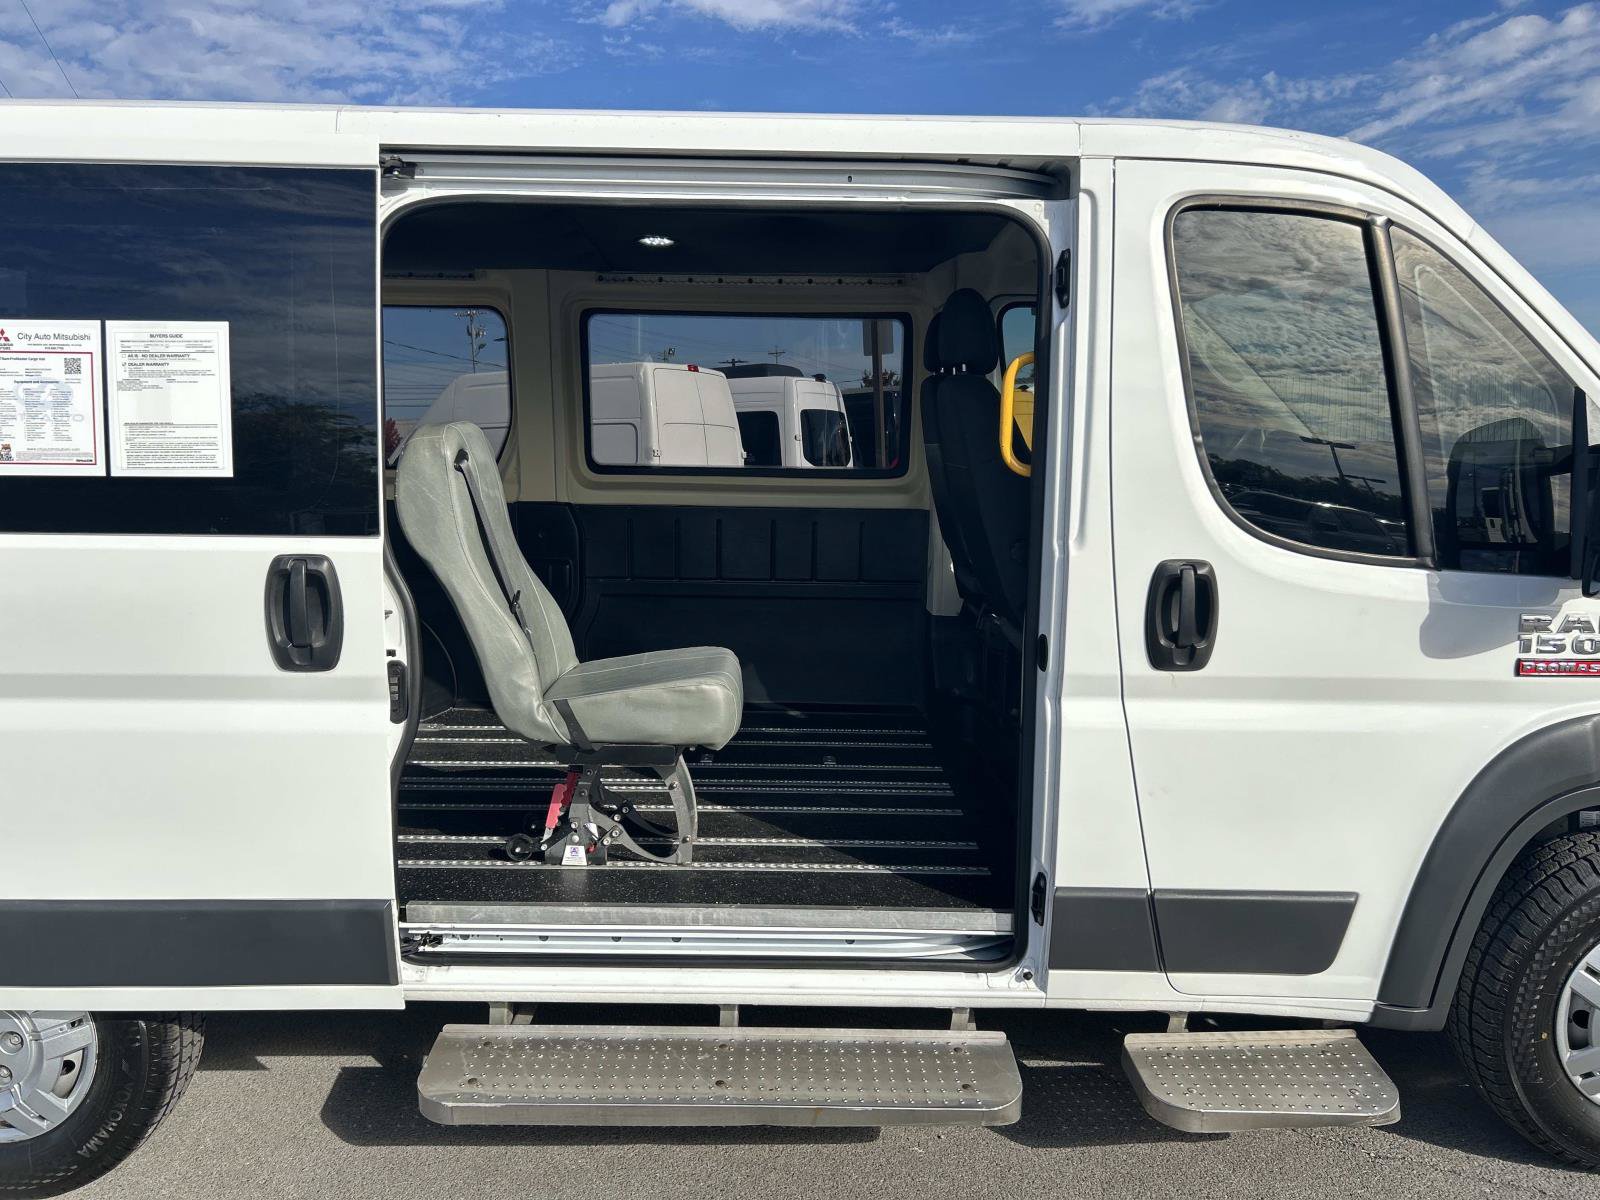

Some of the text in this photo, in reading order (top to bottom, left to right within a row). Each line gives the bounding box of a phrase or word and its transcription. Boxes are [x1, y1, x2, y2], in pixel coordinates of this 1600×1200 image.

[17, 332, 91, 341] City Auto Mitsubishi
[1518, 613, 1600, 633] RA
